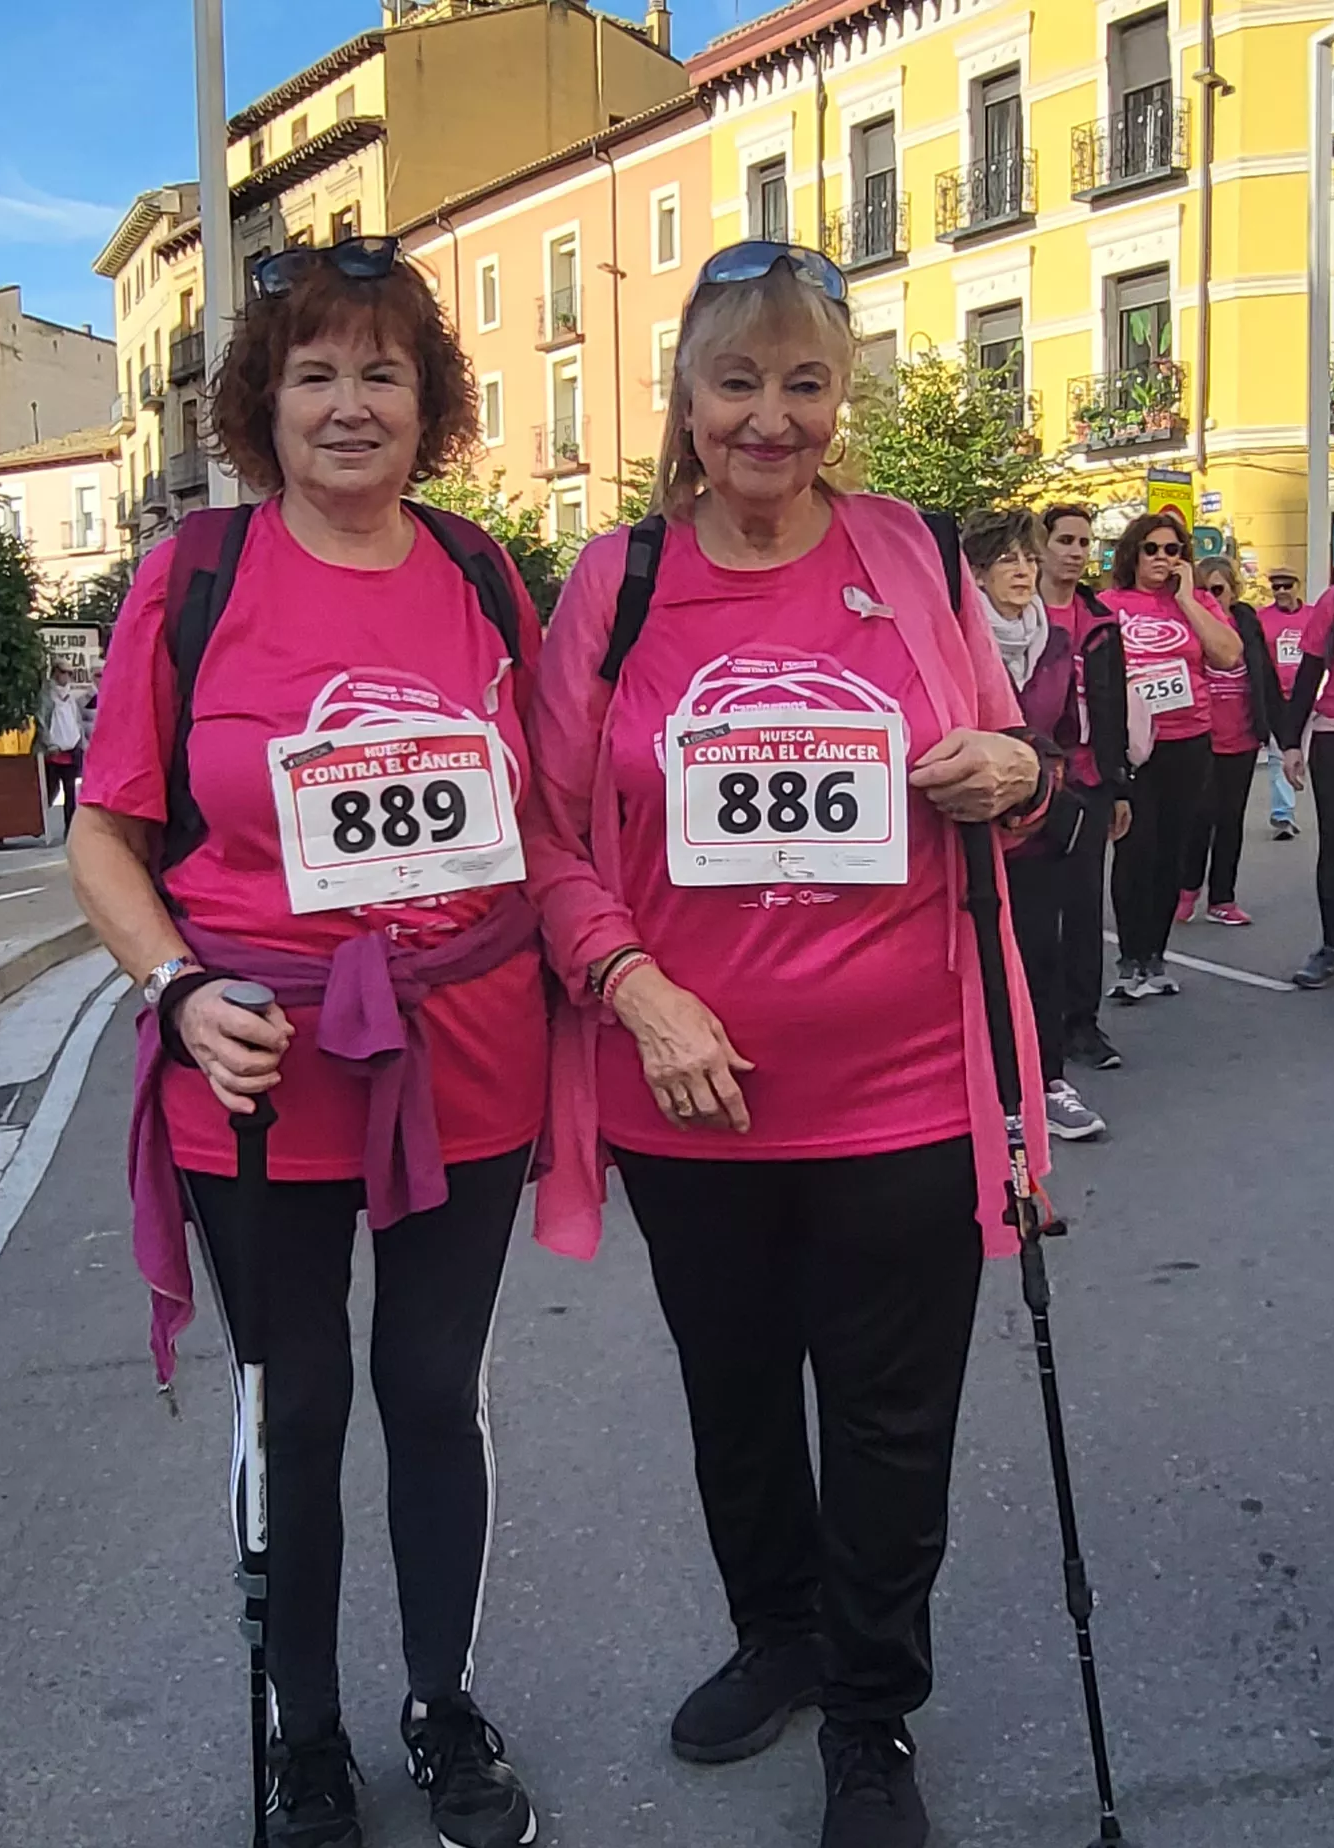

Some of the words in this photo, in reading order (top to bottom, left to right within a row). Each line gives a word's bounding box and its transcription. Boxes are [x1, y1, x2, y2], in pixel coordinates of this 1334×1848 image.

[363, 740, 418, 759] HUESCA
[759, 729, 815, 743] HUESCA
[694, 746, 771, 762] CONTRA
[779, 745, 799, 760] EL
[803, 740, 880, 761] CÁNCER
[301, 761, 381, 785] CONTRA
[386, 757, 404, 775] EL
[407, 751, 483, 772] CÁNCER
[331, 779, 467, 854] 889
[717, 770, 859, 835] 886
